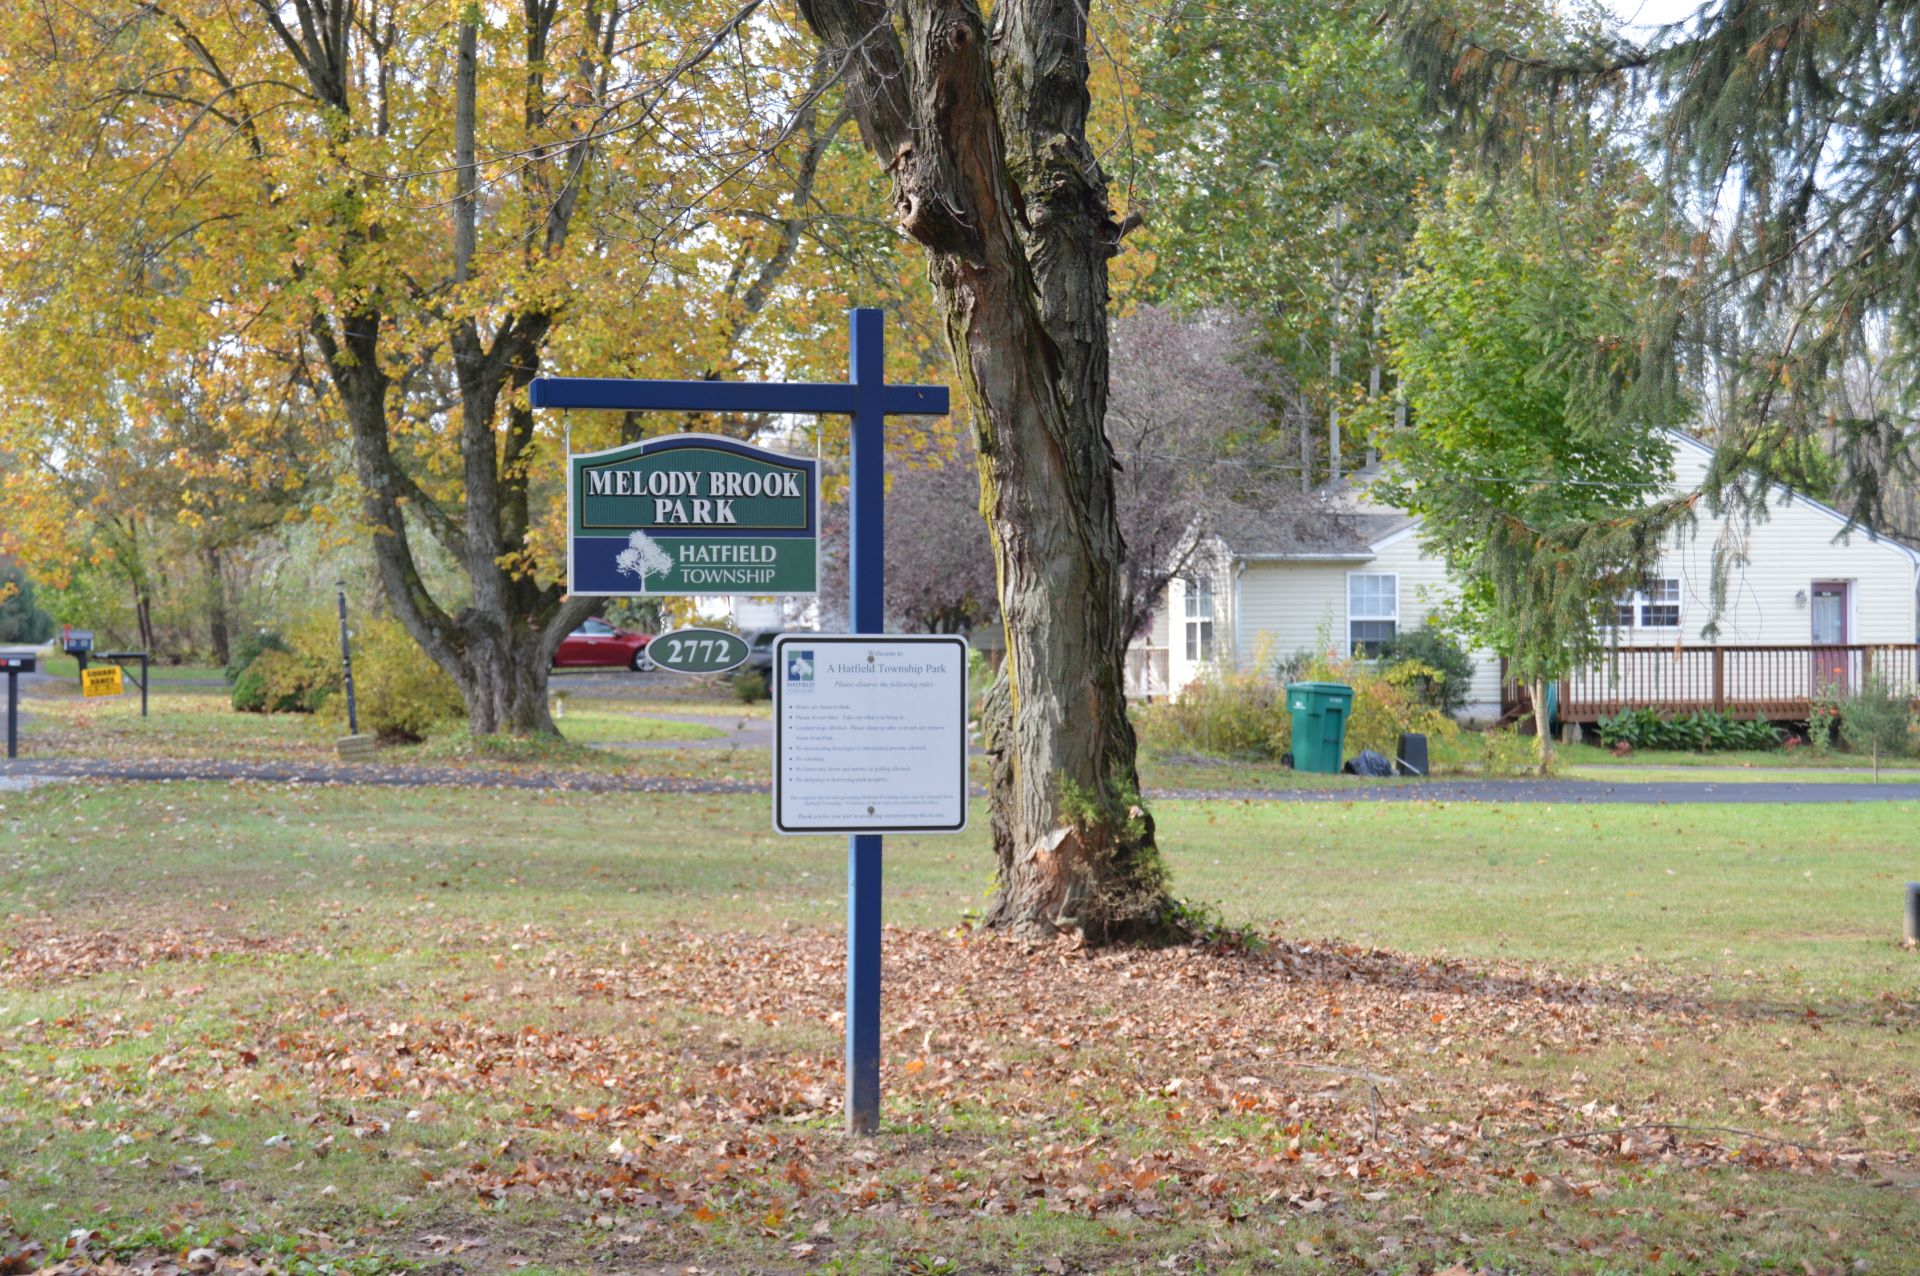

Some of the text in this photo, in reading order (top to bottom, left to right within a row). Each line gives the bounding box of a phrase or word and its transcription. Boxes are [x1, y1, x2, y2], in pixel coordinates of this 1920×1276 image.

[588, 470, 801, 498] MELODY BROOK
[653, 499, 737, 525] PARK
[679, 545, 777, 563] HATFIELD
[680, 569, 776, 584] TOWNSHIP
[667, 639, 731, 663] 2772
[827, 663, 946, 676] A Hatfield Township Park
